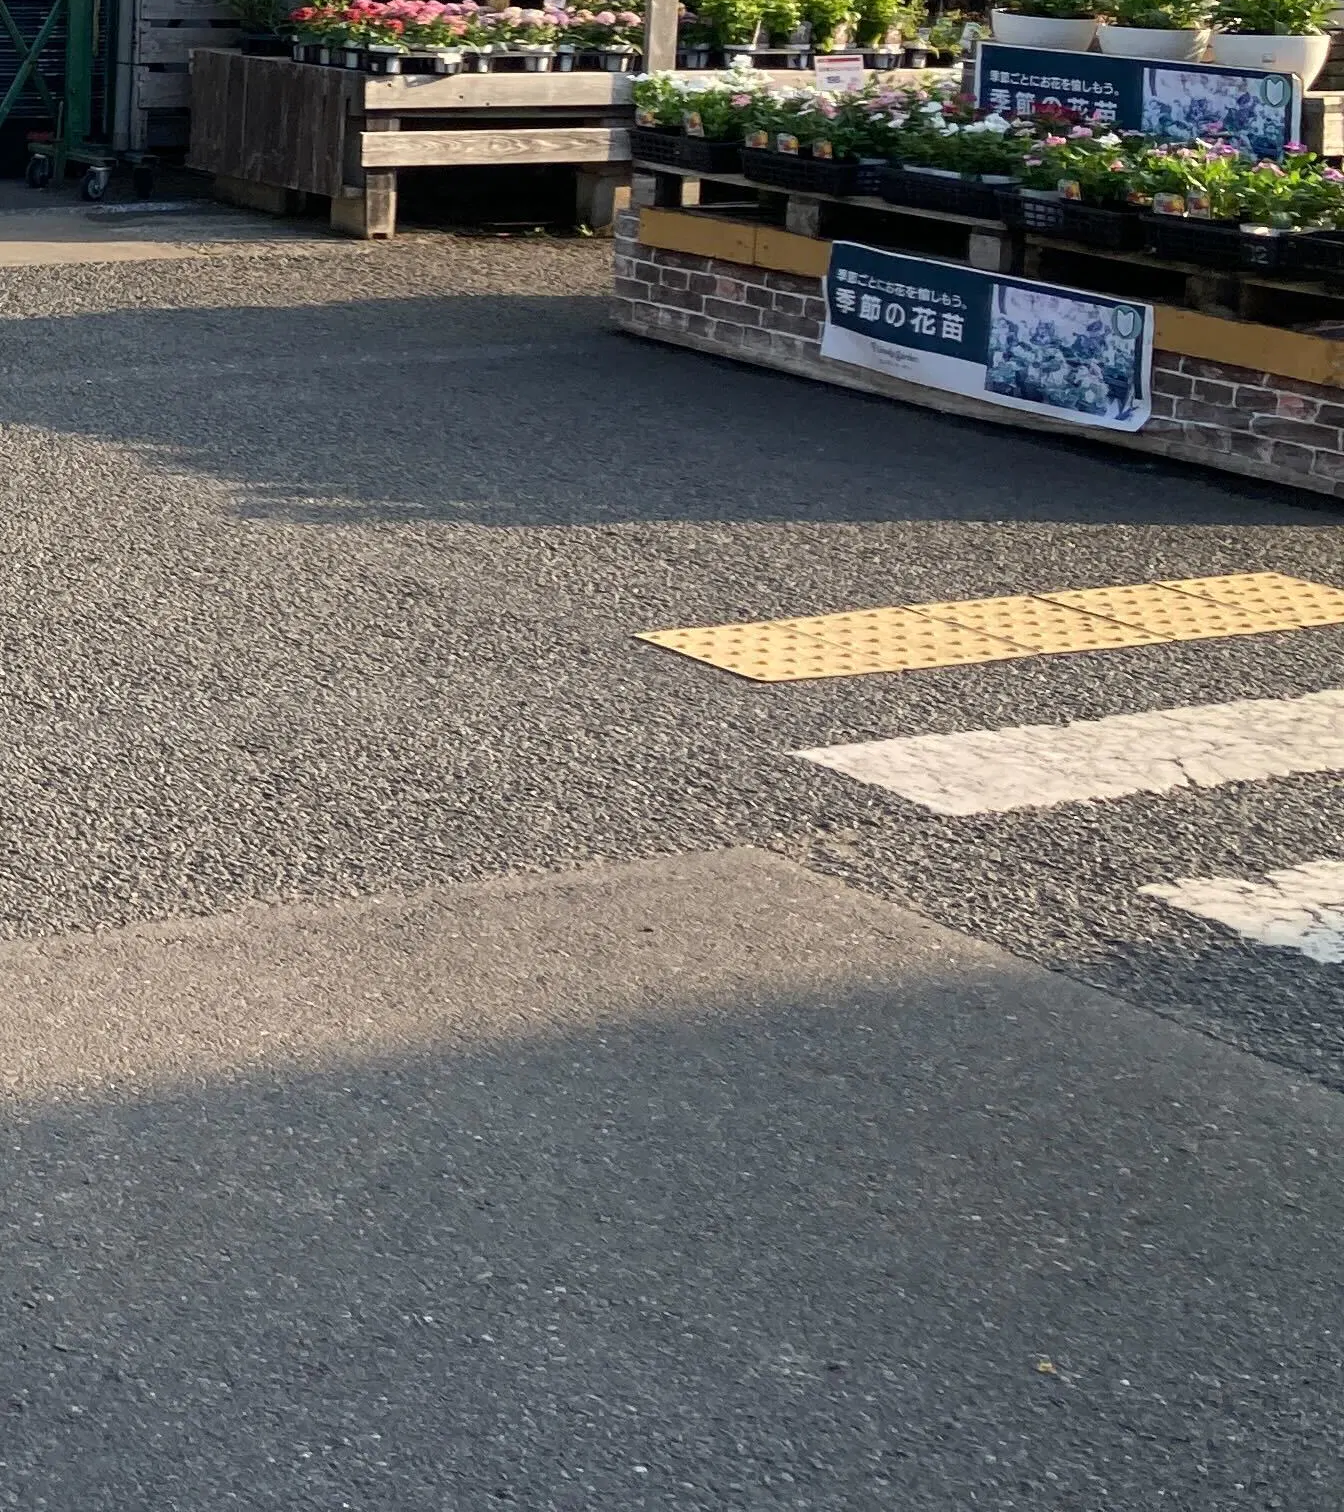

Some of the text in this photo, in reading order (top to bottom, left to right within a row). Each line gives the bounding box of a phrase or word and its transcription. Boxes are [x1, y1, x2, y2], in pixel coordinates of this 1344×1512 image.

[835, 287, 965, 342] 季節の花苗
